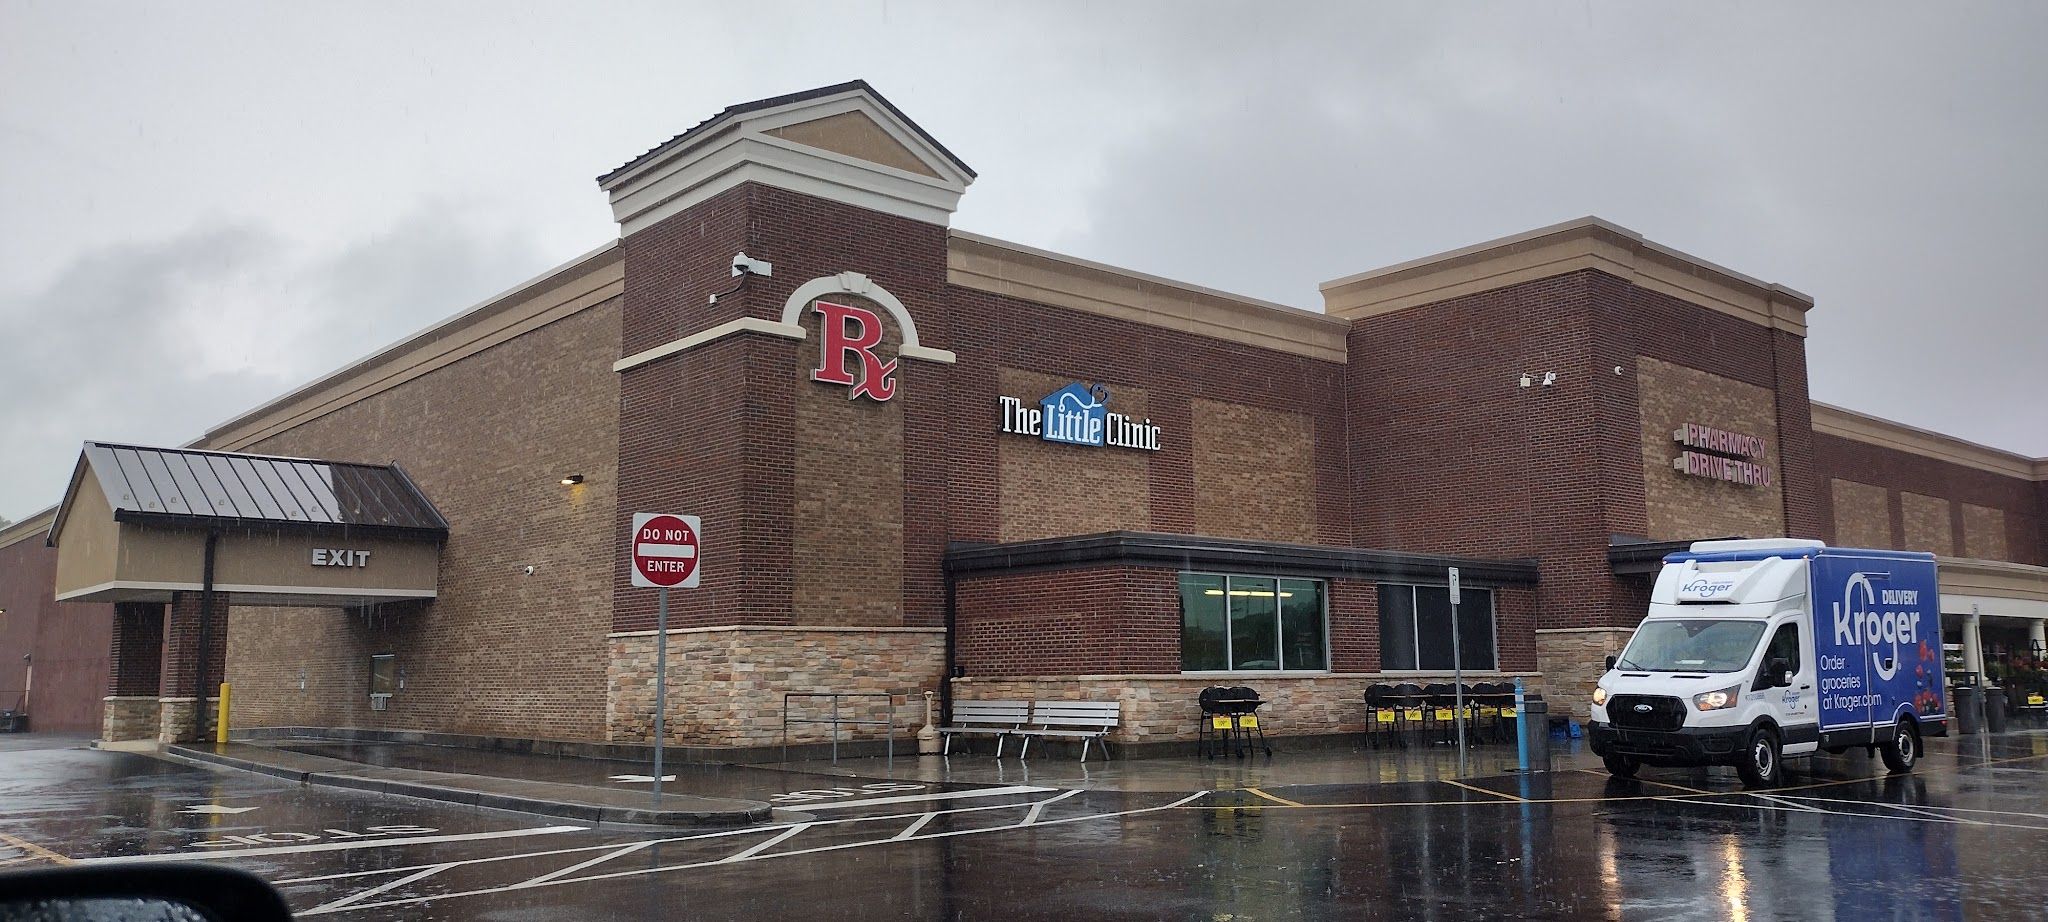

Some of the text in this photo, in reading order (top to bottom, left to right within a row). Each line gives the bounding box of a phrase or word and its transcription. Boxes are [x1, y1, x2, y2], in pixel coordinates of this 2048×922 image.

[999, 395, 1161, 450] The Little Clinic
[1688, 423, 1766, 459] PHARMACY
[1688, 451, 1771, 488] DRIVE THRU
[643, 528, 690, 542] DO NOT
[312, 548, 371, 567] EXIT
[647, 560, 685, 573] ENTER
[1682, 579, 1732, 597] Kroger
[1881, 589, 1919, 605] DELIVERY
[1832, 572, 1920, 681] Kroger
[1820, 654, 1846, 671] Order
[1821, 673, 1861, 695] groceries
[1823, 693, 1882, 712] at Kroger.com
